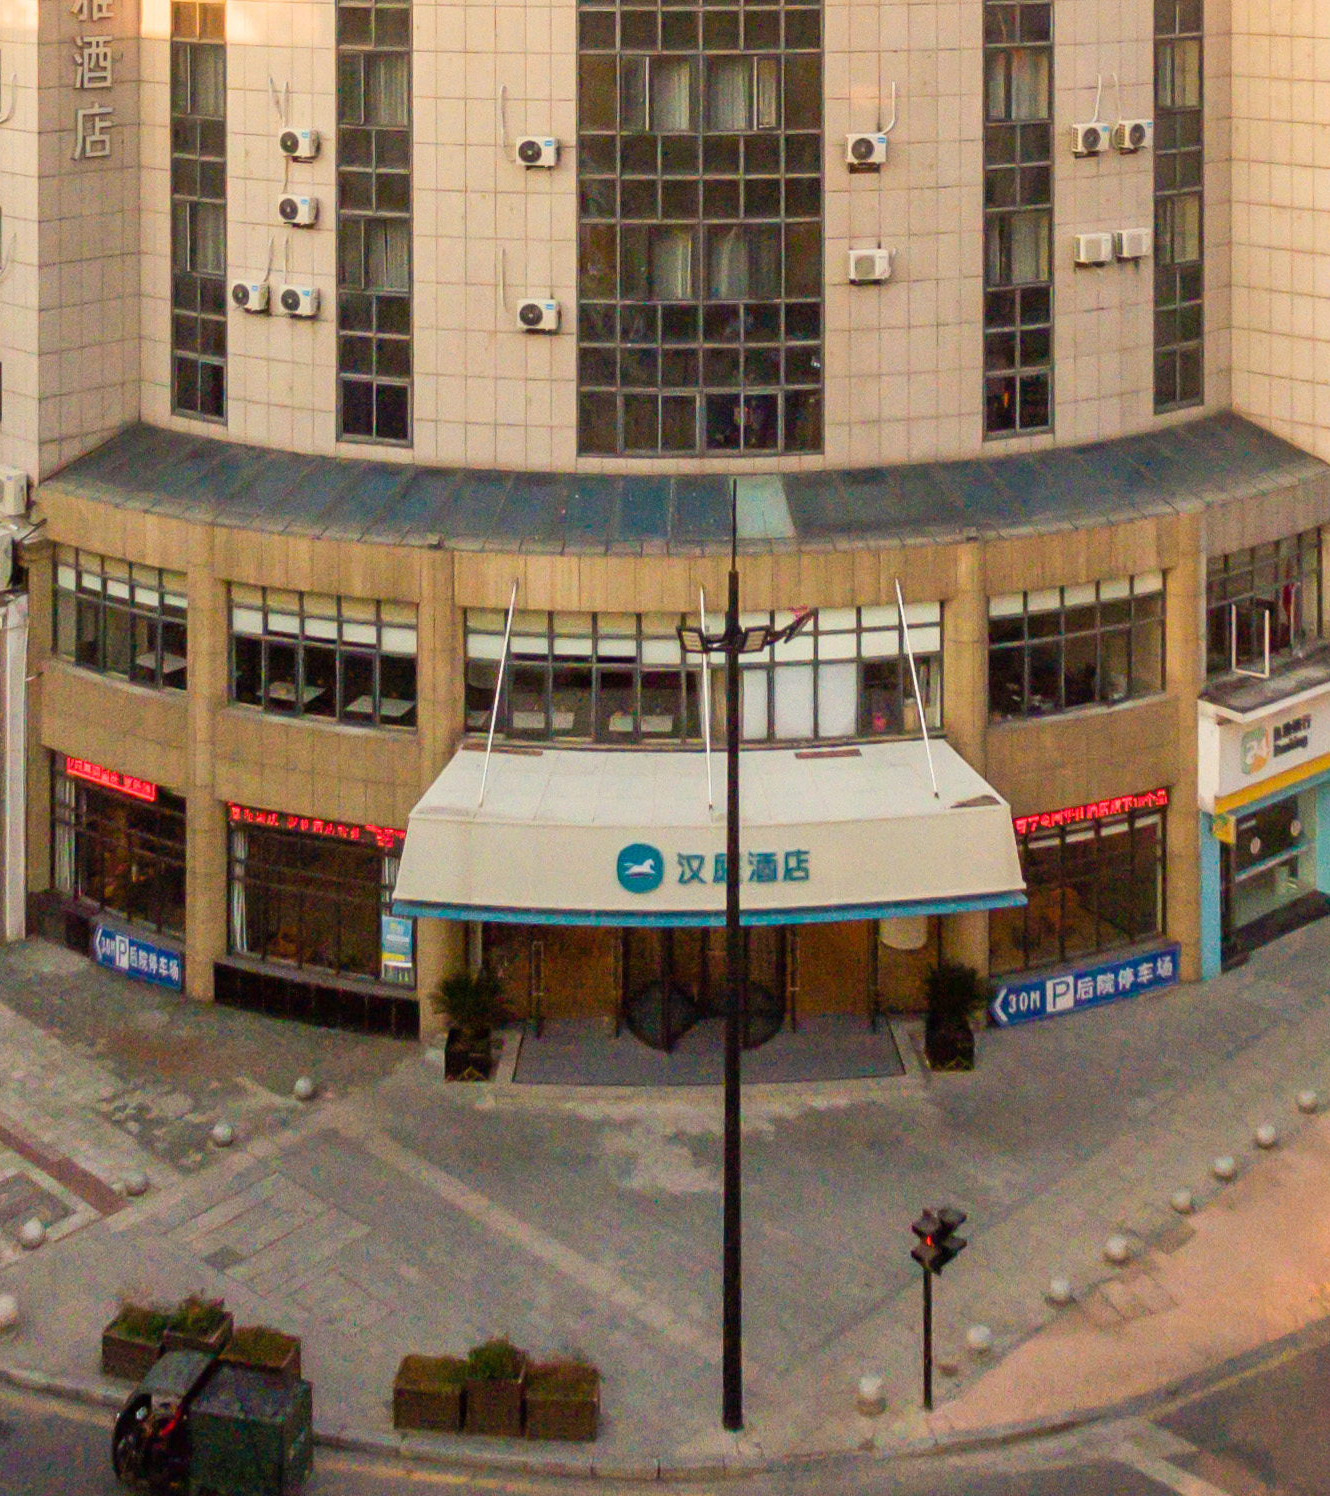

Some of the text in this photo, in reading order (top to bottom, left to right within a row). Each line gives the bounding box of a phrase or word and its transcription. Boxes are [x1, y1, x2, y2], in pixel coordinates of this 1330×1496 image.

[1076, 955, 1174, 1001] 后院停车场
